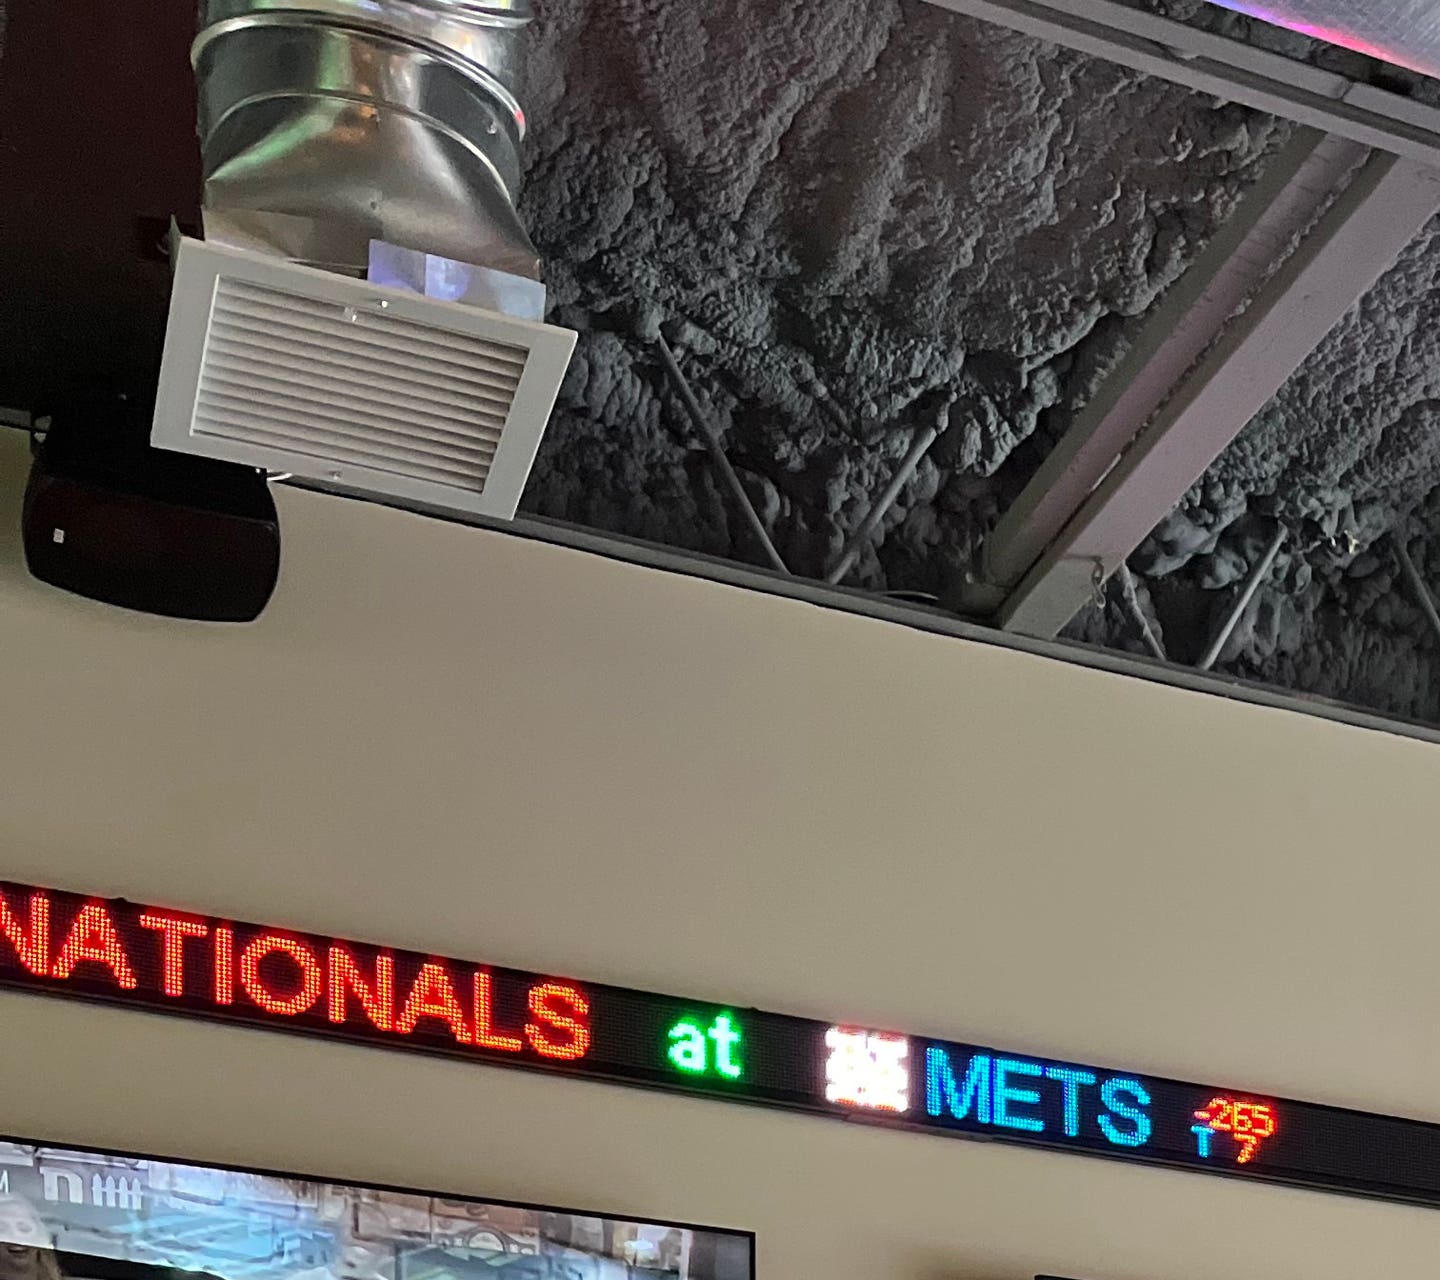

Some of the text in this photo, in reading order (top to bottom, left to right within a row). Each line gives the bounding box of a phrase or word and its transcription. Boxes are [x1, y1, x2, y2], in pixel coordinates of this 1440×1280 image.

[0, 896, 591, 1060] NATIONALS
[667, 1010, 743, 1079] at
[925, 1047, 1152, 1148] METS
